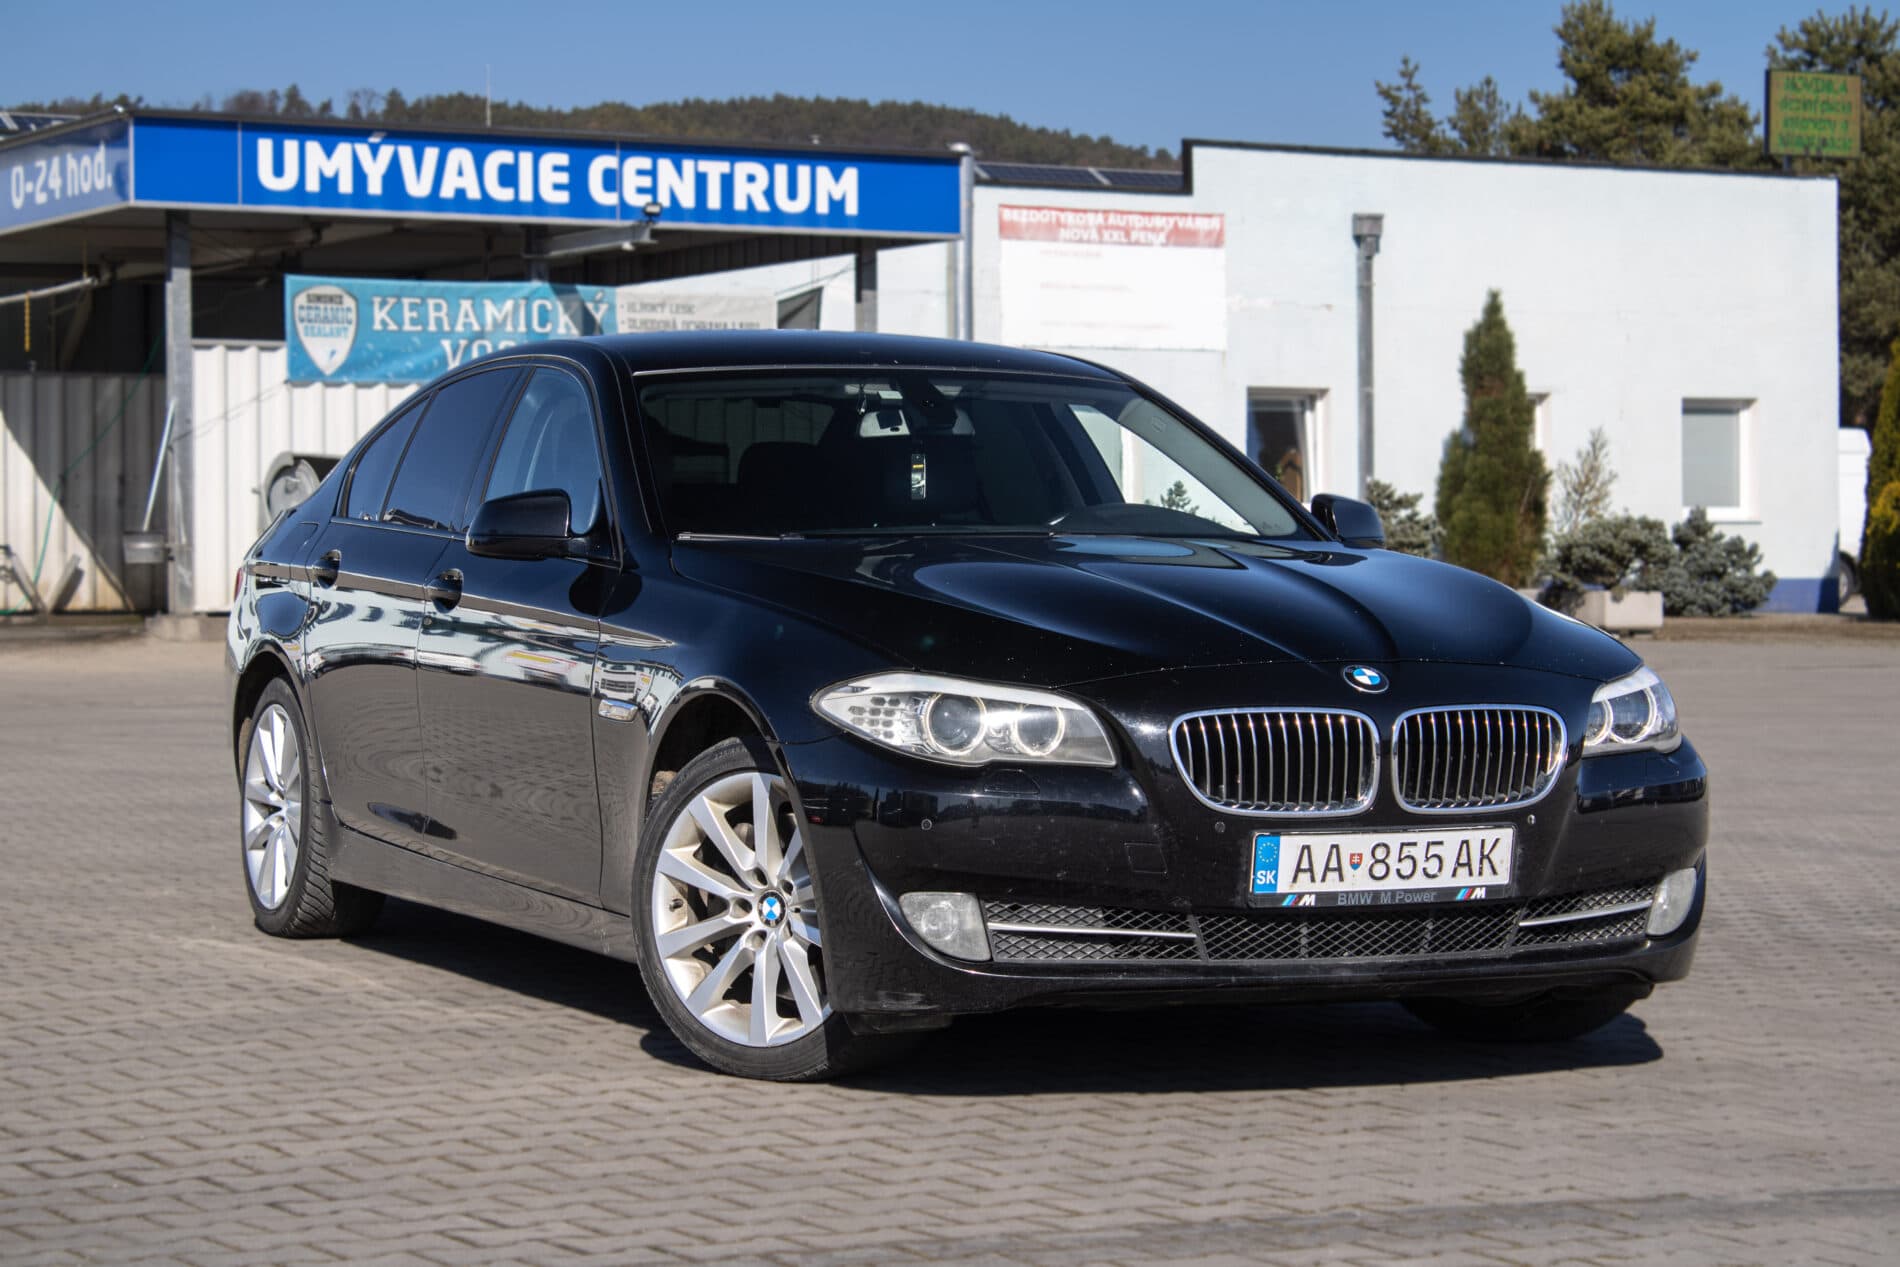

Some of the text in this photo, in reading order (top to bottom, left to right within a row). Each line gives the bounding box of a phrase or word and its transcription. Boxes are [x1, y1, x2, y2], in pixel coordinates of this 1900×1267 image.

[10, 141, 113, 209] 0-24 hod.
[257, 131, 859, 215] UMÝVACIE CENTRUM
[372, 291, 609, 336] KERAMICKÝ
[1256, 870, 1276, 885] SK
[1291, 843, 1345, 883] AA
[1337, 891, 1373, 905] BMW
